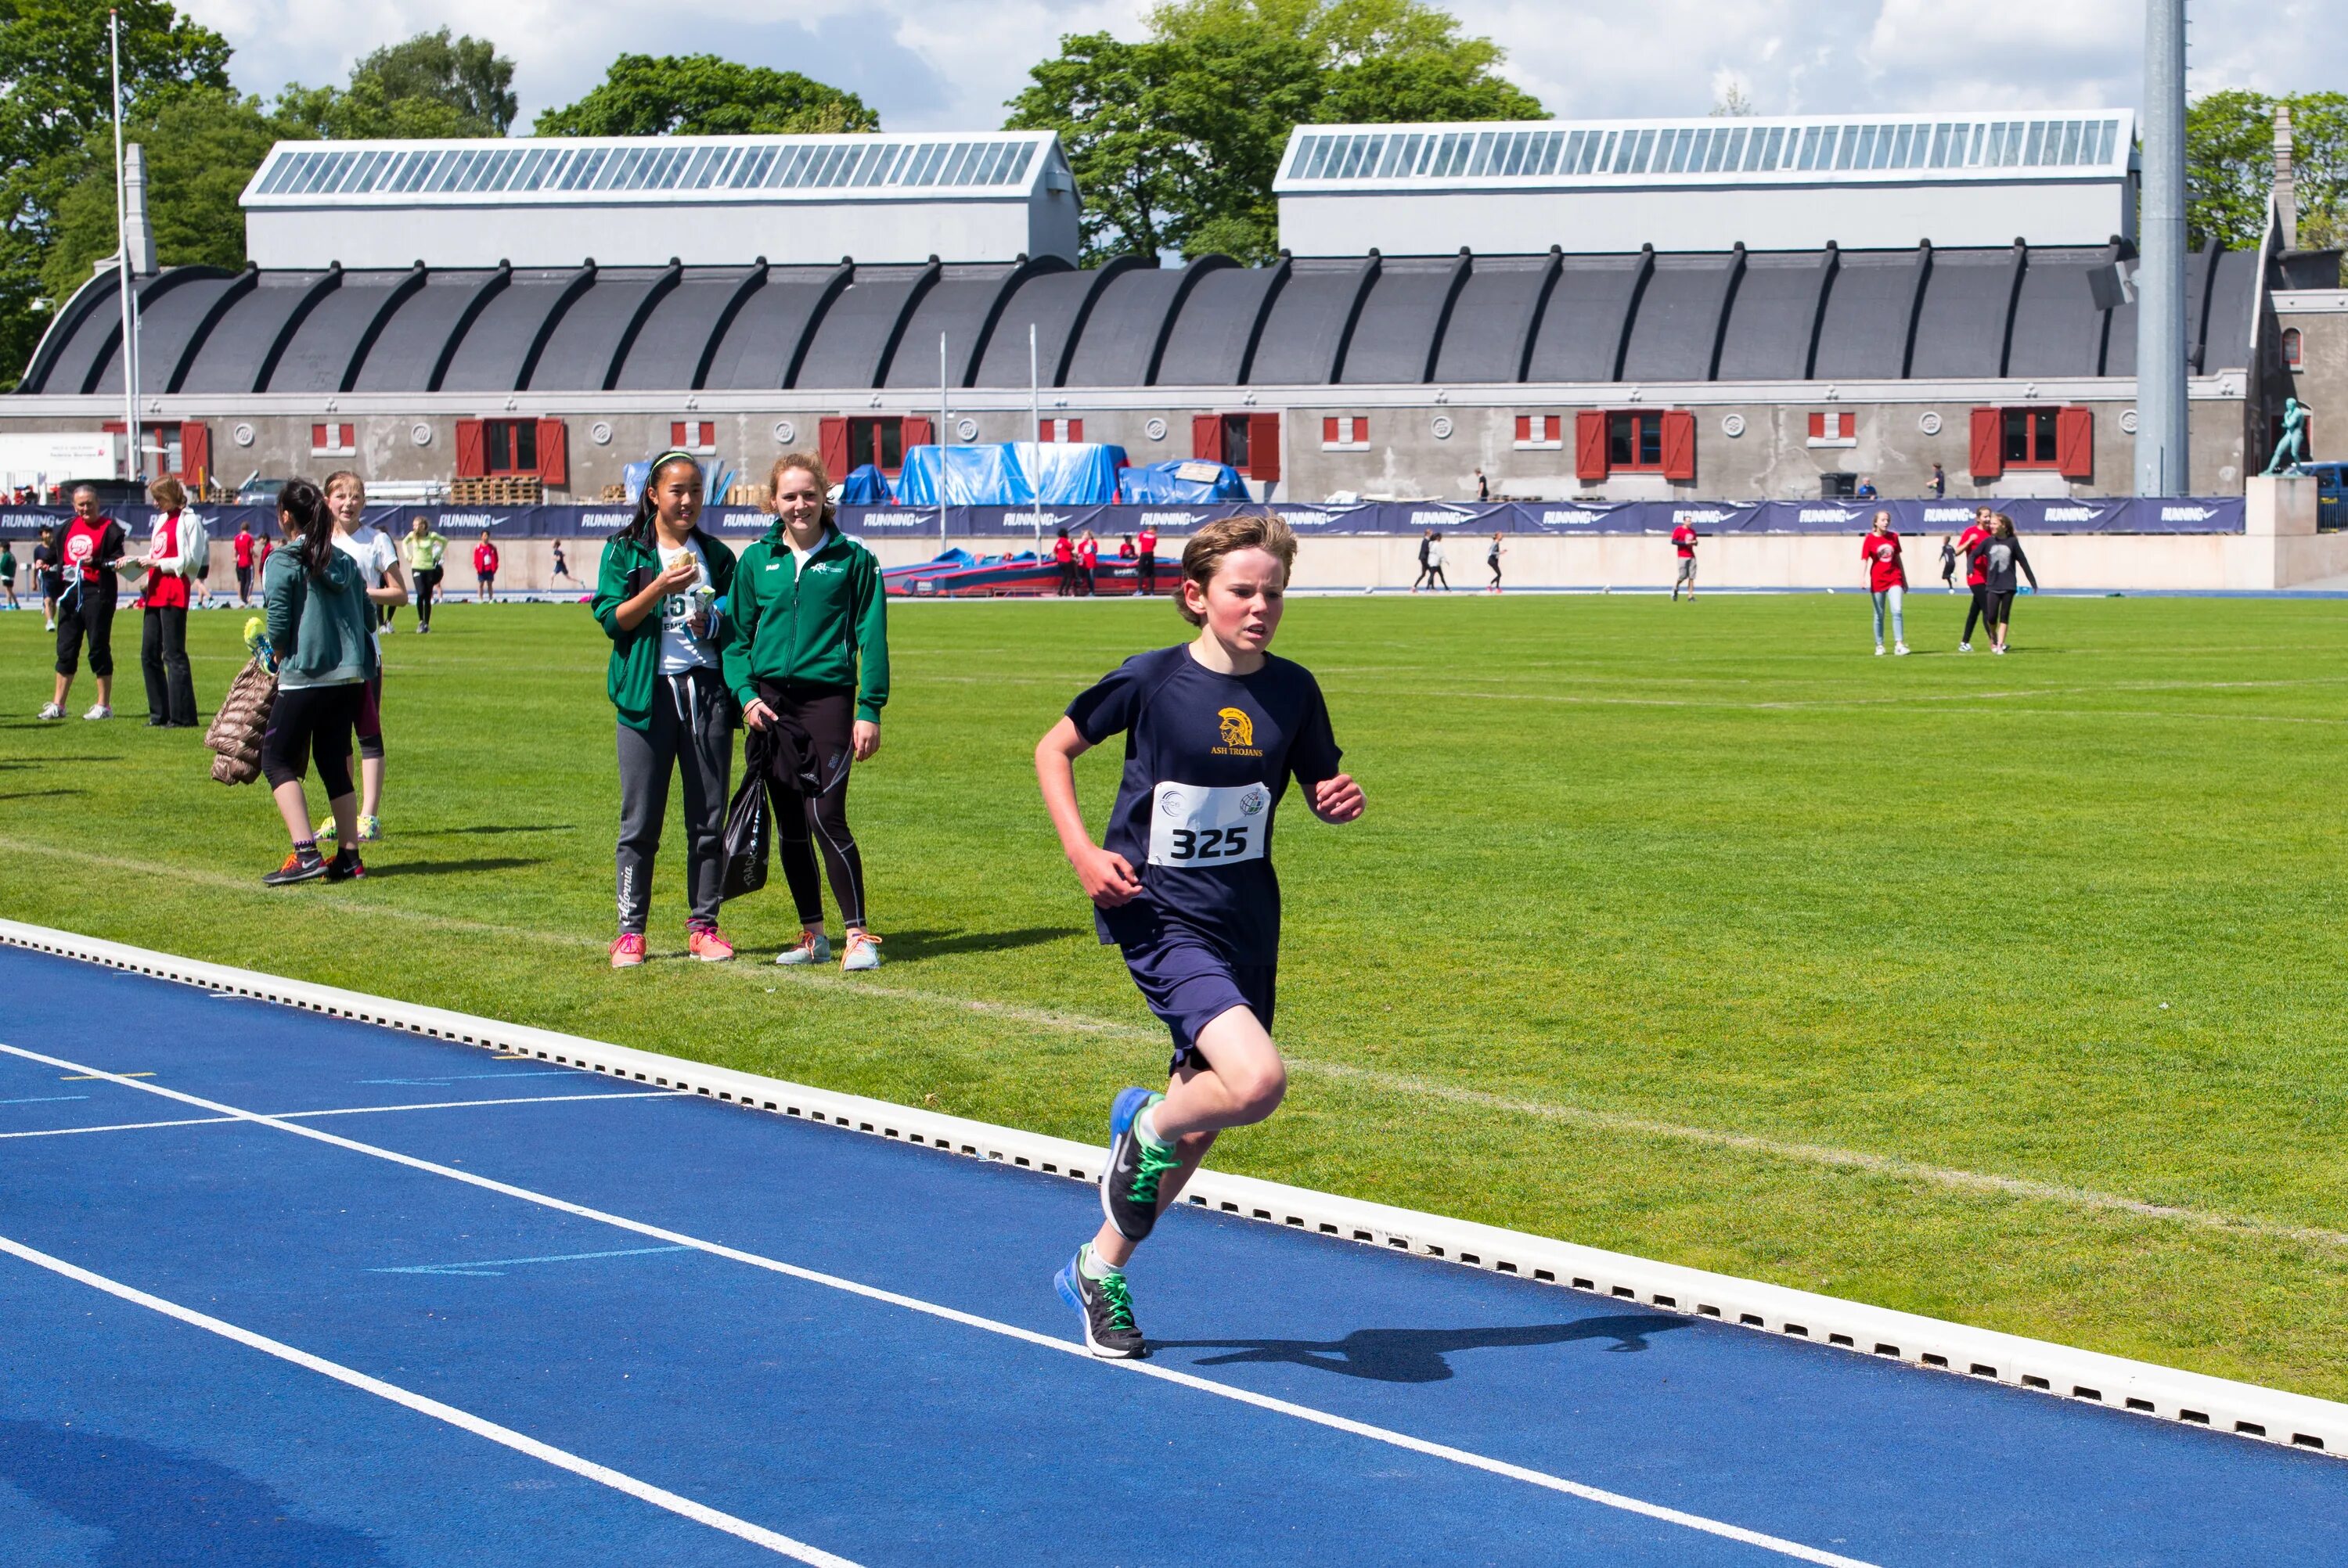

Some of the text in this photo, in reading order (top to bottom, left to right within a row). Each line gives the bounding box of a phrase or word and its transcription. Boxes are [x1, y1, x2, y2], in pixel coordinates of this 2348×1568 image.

[2, 514, 55, 527] RUNNING
[438, 513, 491, 527] RUNNING
[582, 513, 634, 527] RUNNING
[723, 513, 775, 527] RUNNING
[863, 512, 915, 527] RUNNING
[1003, 512, 1054, 526] RUNNNG
[1140, 512, 1191, 525] RUNNING
[1410, 511, 1460, 524] RUNNING
[1543, 511, 1592, 524] RUNNING
[1799, 509, 1846, 523] RUNNING
[1923, 508, 1970, 522] RUNNING
[2044, 507, 2089, 521] RUNNING
[2161, 507, 2204, 521] RUNNING
[1211, 746, 1263, 757] ASH TROJANS
[1171, 826, 1248, 859] 325
[744, 851, 758, 886] TRACK
